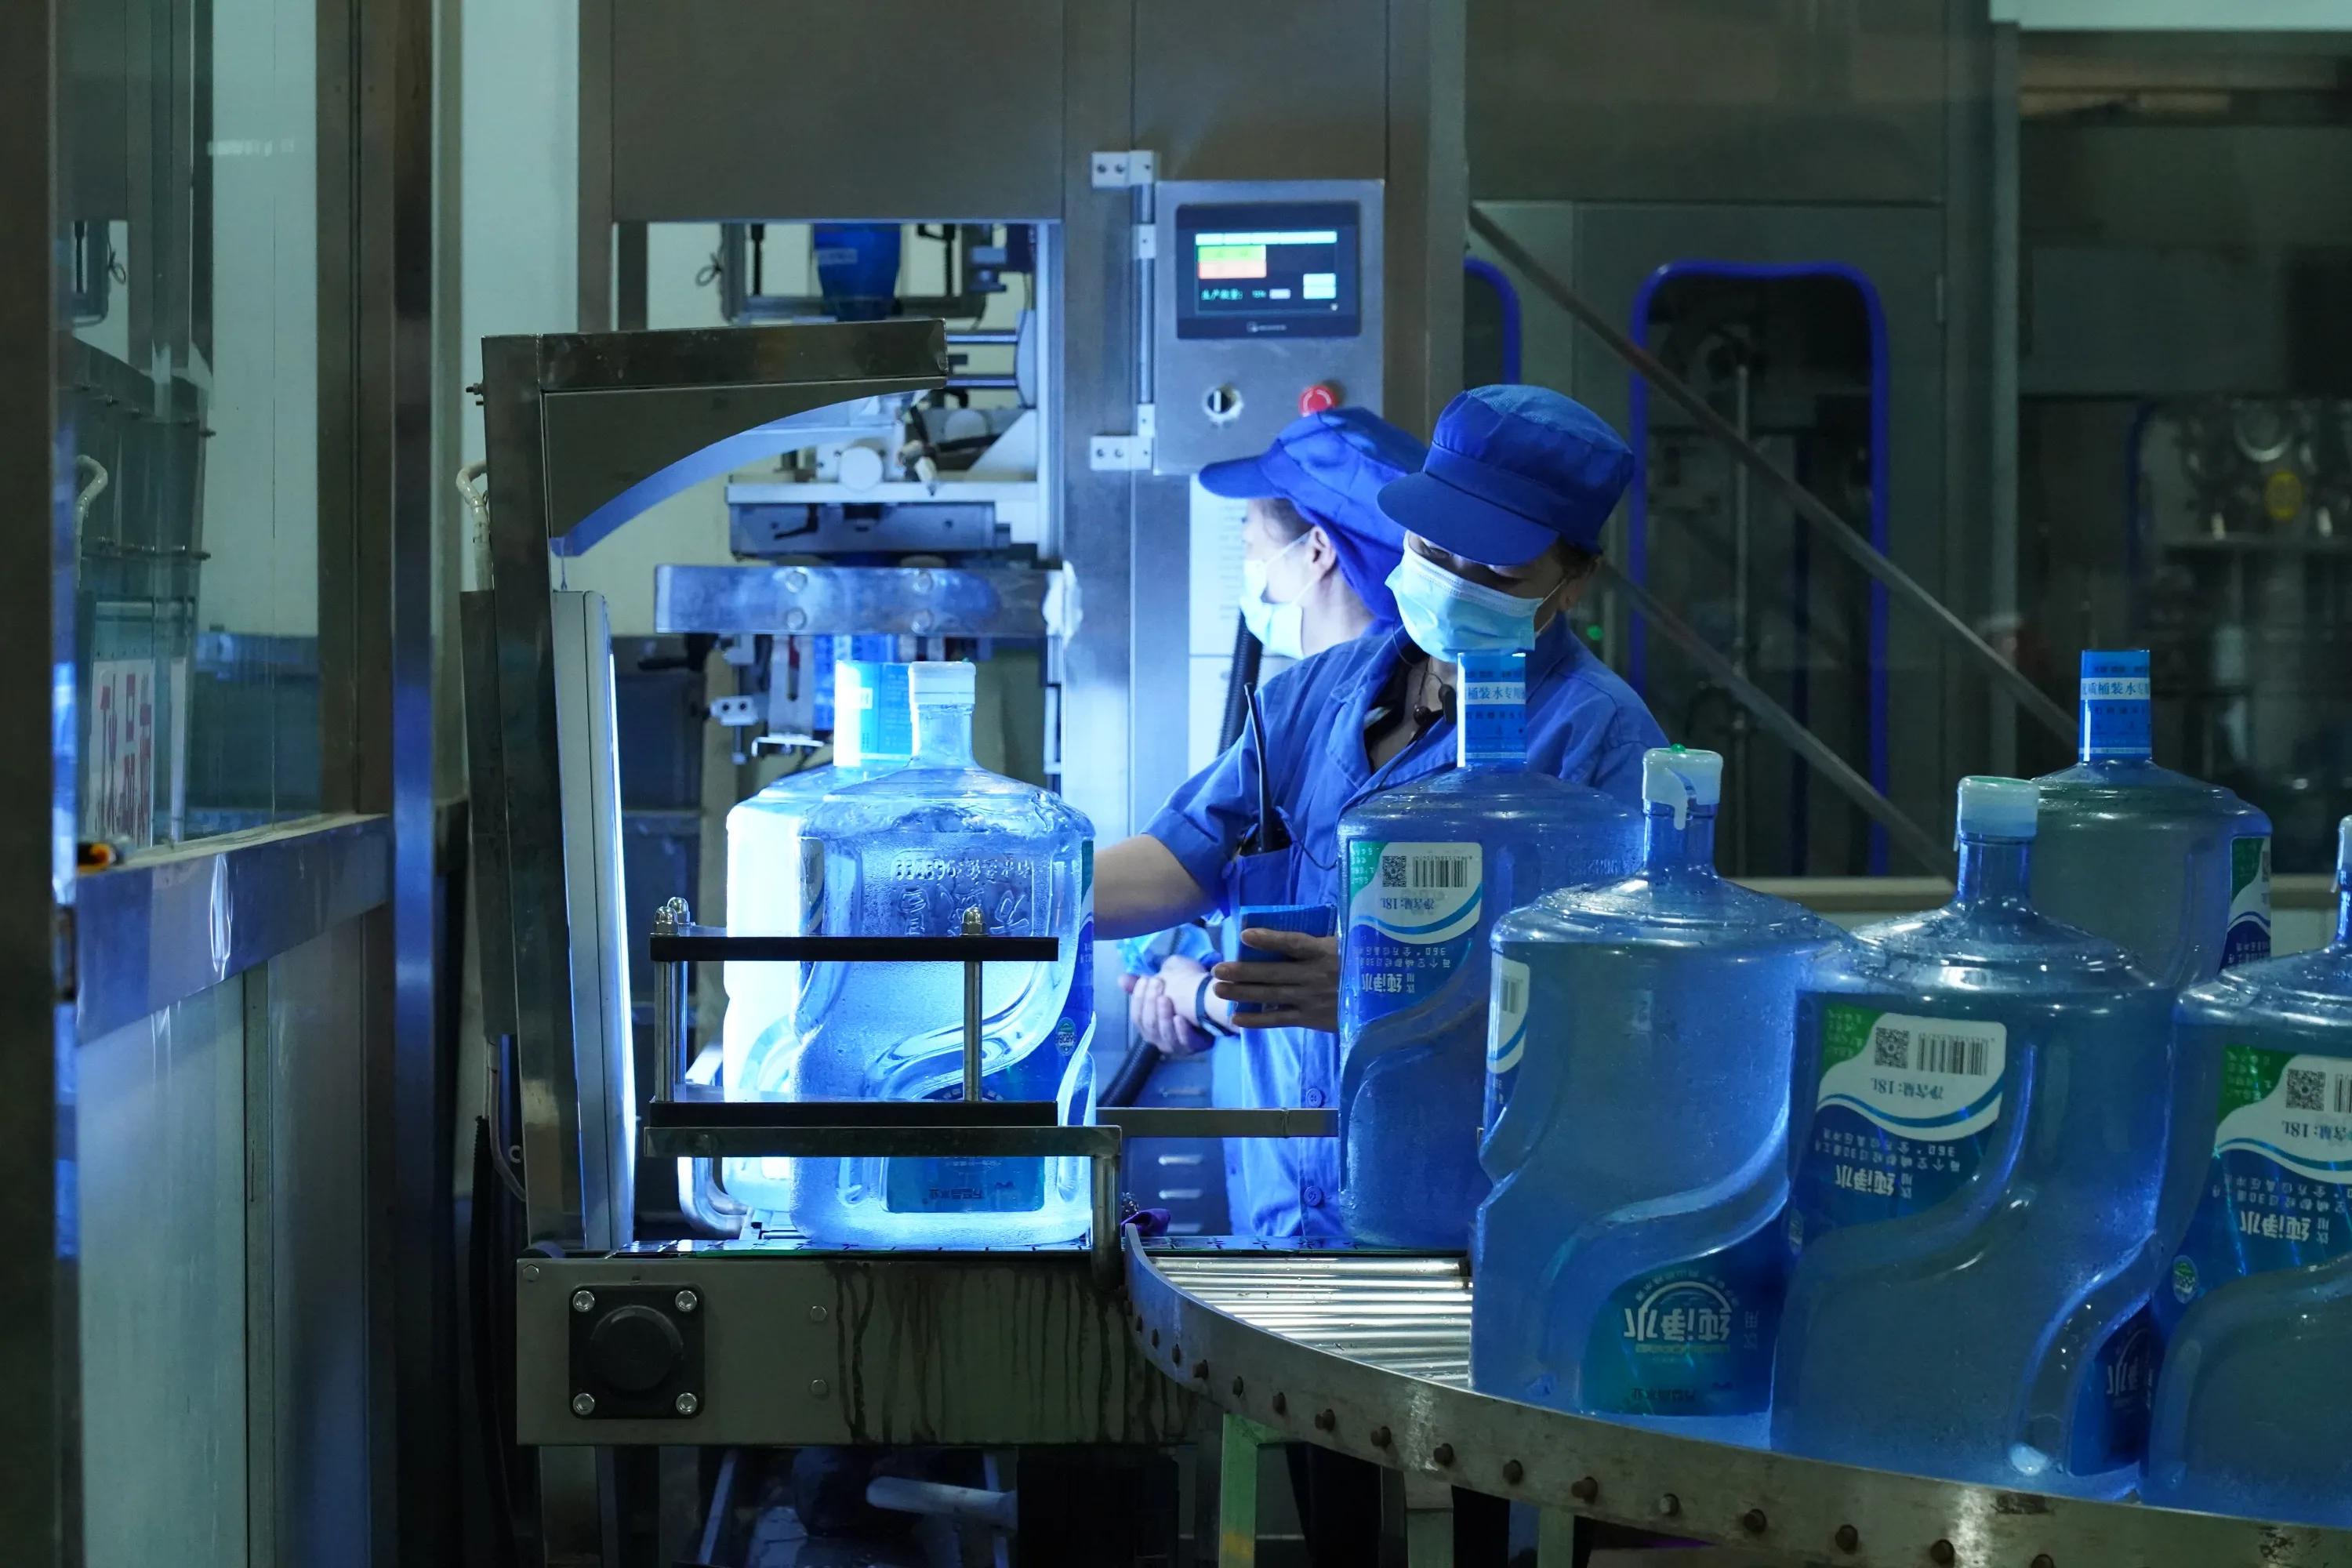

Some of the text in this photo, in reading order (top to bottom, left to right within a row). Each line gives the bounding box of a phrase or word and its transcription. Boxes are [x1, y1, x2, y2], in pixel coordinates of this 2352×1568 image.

[1361, 973, 1403, 993] 纯净水
[1870, 1078, 1944, 1099] 净含量:18L
[1832, 1164, 1895, 1196] 纯净水
[2239, 1210, 2311, 1242] 纯净水
[1623, 1308, 1732, 1342] 纯净水
[1744, 1311, 1759, 1350] 饮用
